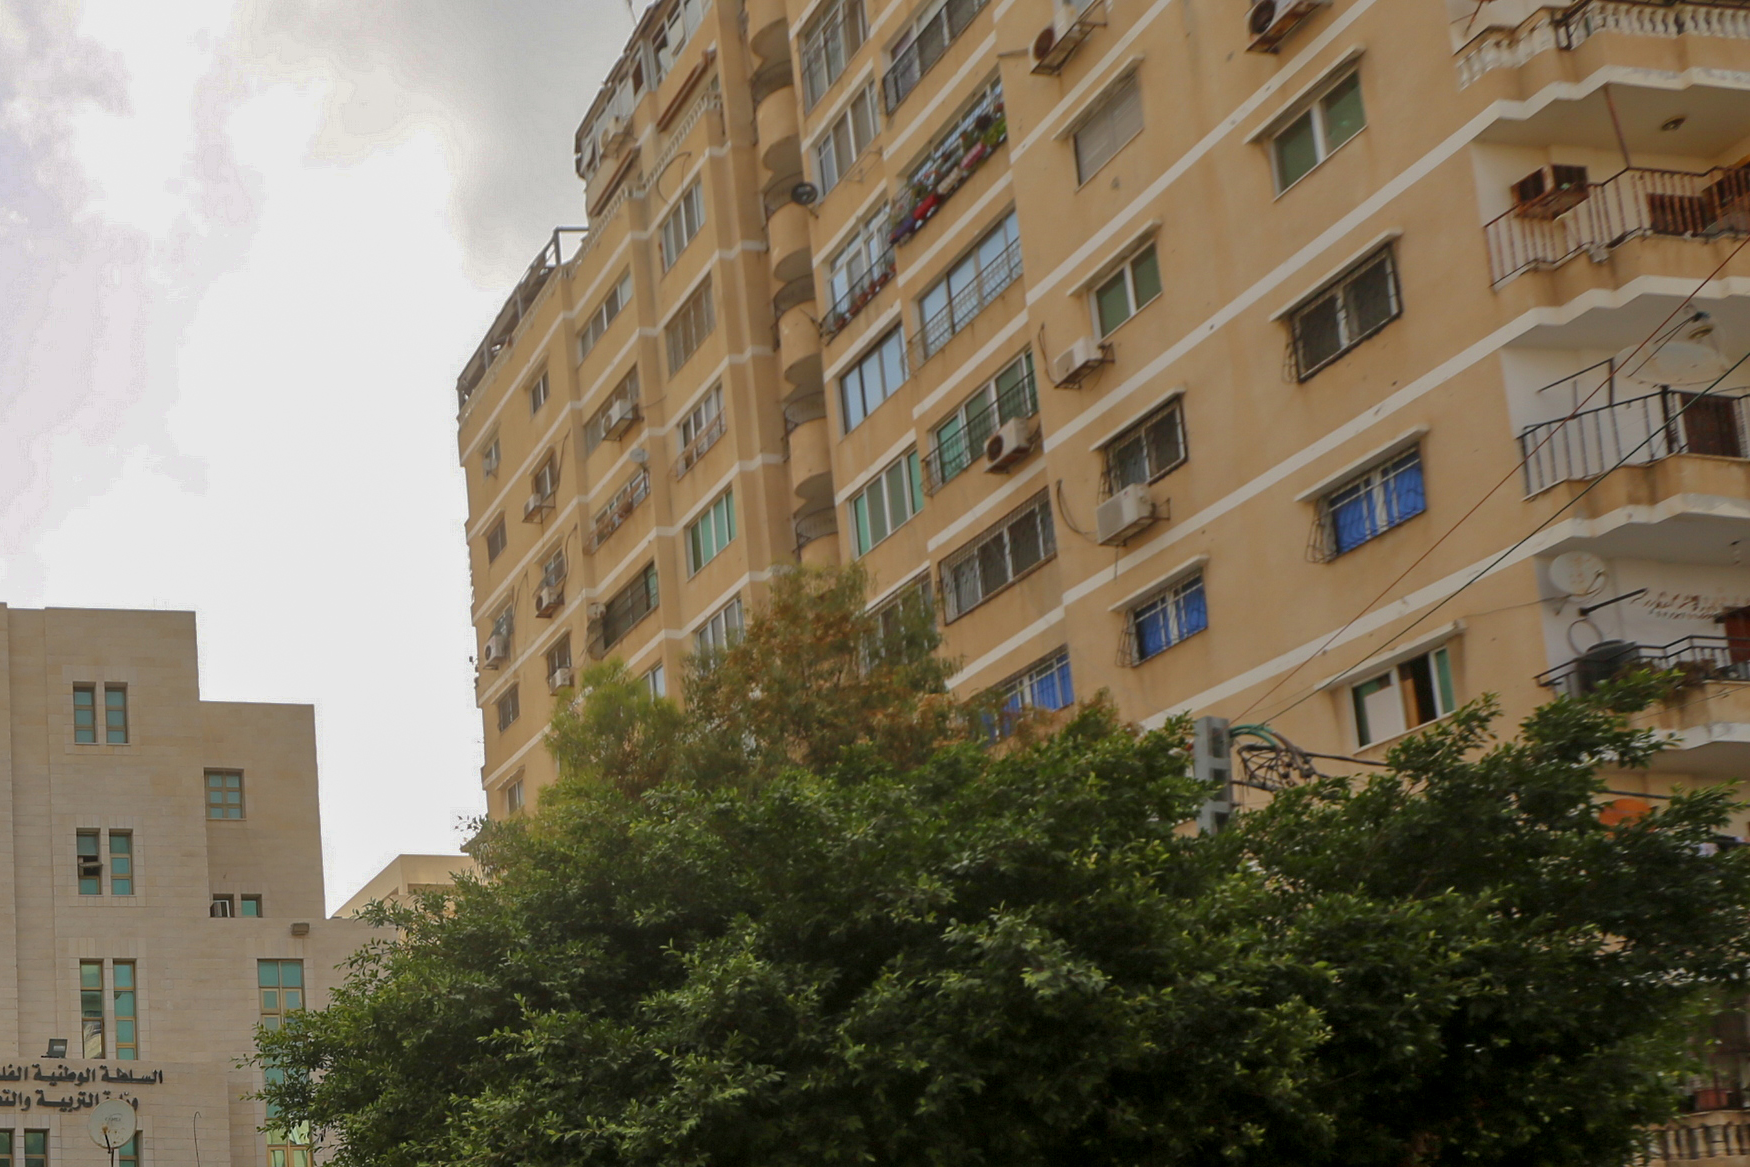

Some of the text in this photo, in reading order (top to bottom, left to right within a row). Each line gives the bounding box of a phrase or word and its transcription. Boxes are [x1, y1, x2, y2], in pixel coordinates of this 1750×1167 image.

[32, 1063, 96, 1086] الوطنية
[100, 1065, 163, 1084] السلطة
[35, 1090, 100, 1112] التربية
